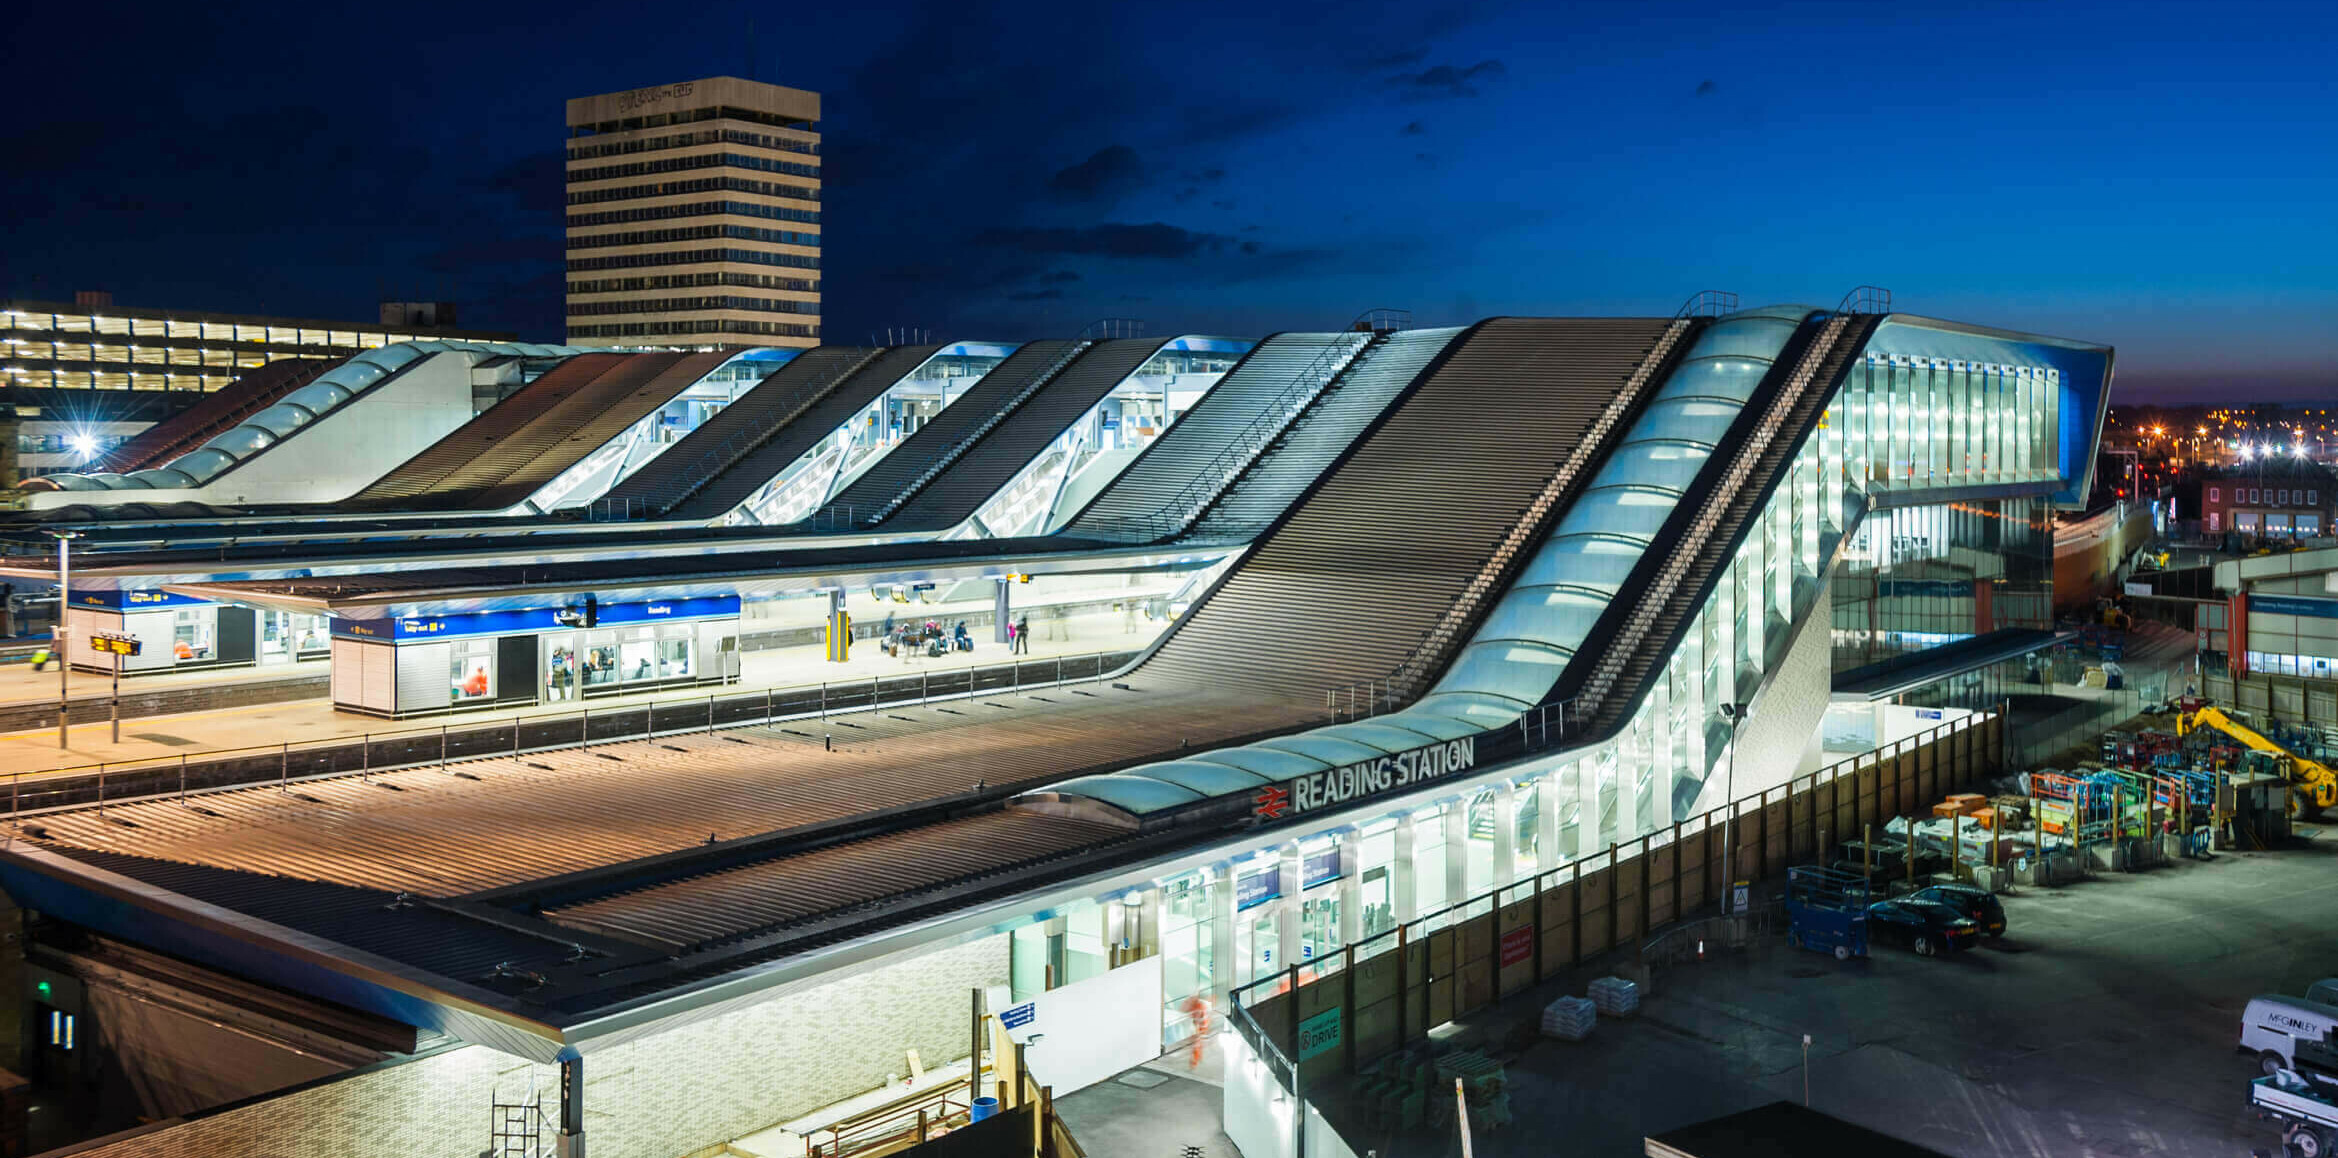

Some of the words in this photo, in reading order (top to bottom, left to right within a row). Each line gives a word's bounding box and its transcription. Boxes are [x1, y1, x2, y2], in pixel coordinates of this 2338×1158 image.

[1295, 761, 1391, 813] READING
[1397, 737, 1475, 786] STATION
[1312, 1025, 1338, 1047] DRIVE
